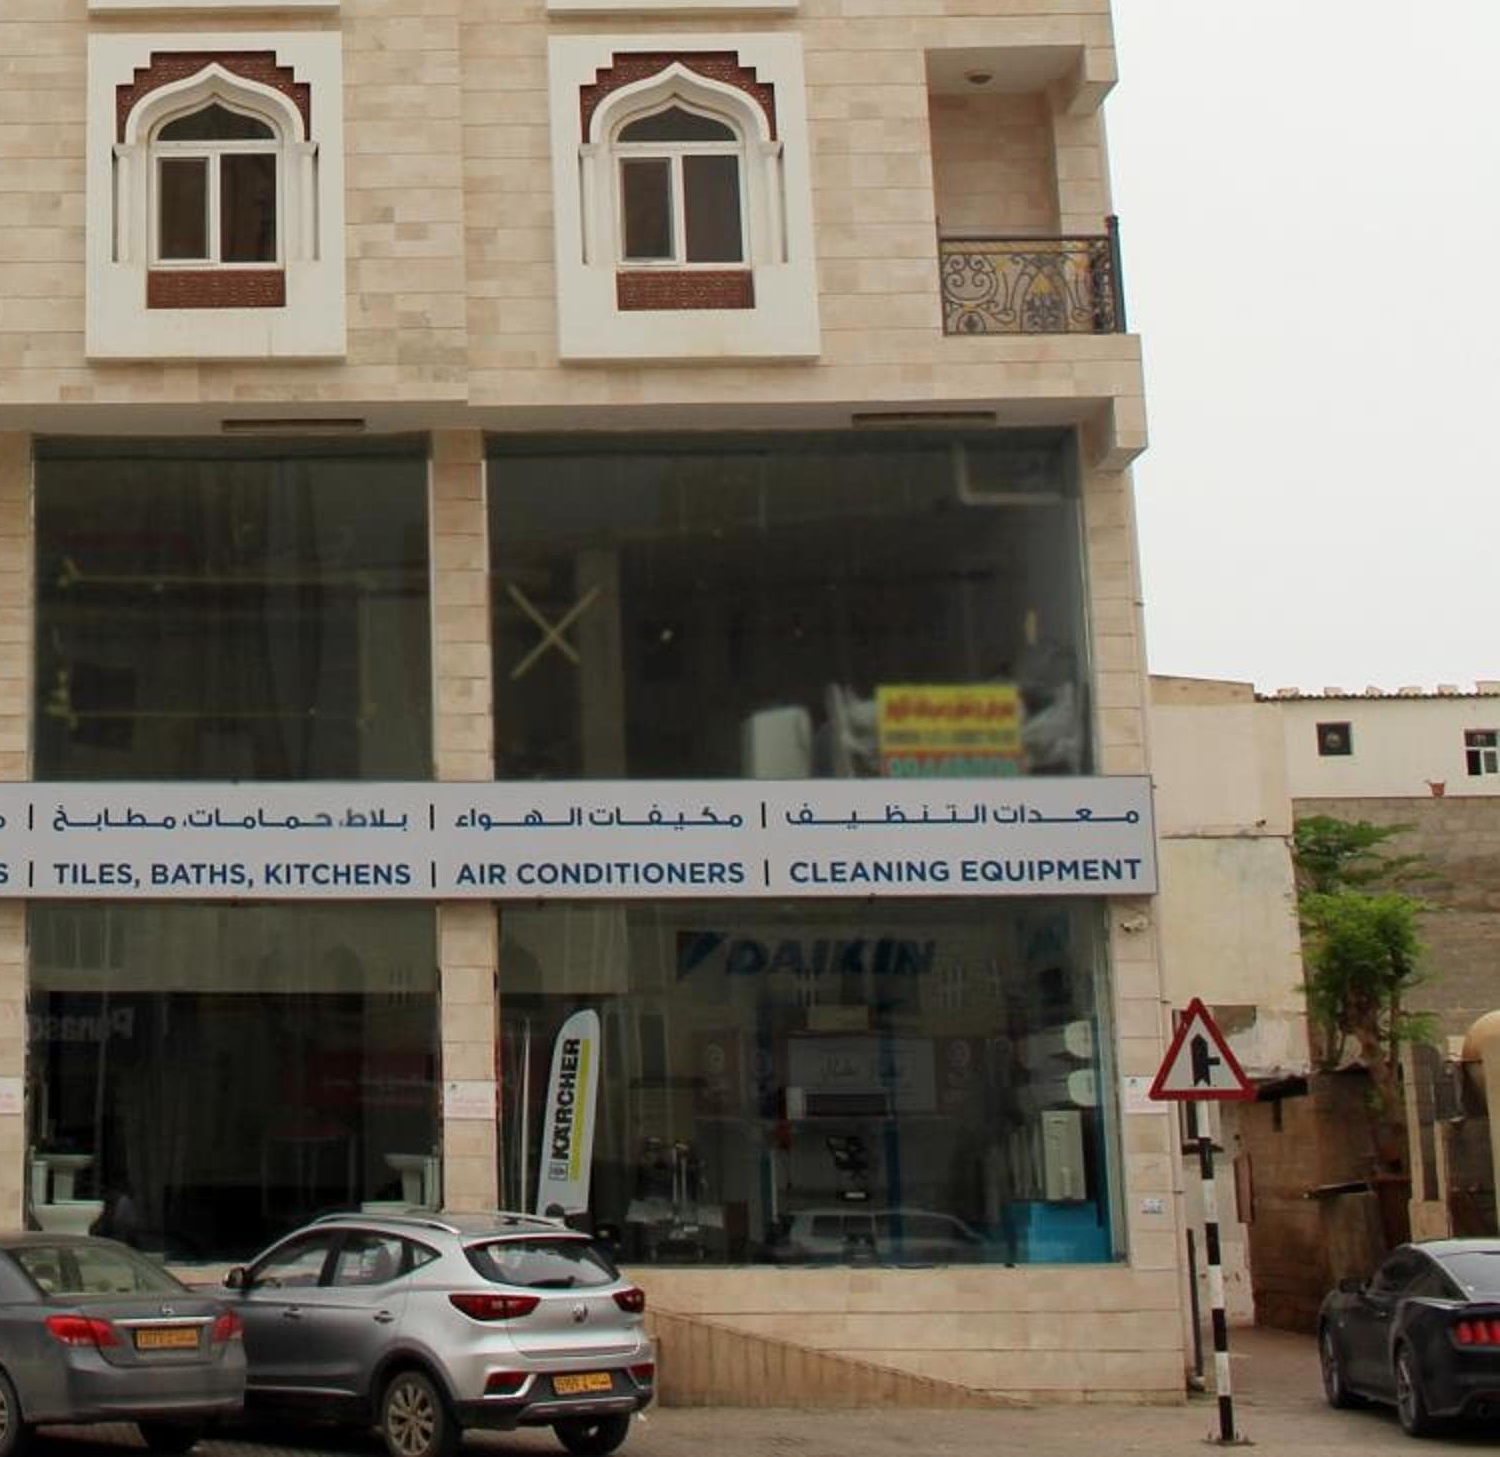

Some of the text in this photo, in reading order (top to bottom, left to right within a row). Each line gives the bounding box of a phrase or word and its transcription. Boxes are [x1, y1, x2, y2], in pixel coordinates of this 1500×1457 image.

[53, 804, 176, 831] مطابخ
[455, 805, 742, 831] مكيفات الهواء
[786, 803, 1139, 829] معدات التنظيف
[53, 863, 411, 888] TILES, BATHS, KITCHENS
[456, 862, 744, 885] AIR CONDITIONERS
[789, 858, 1141, 883] CLEANING EQUIPMENT
[724, 939, 936, 975] DAIKIN
